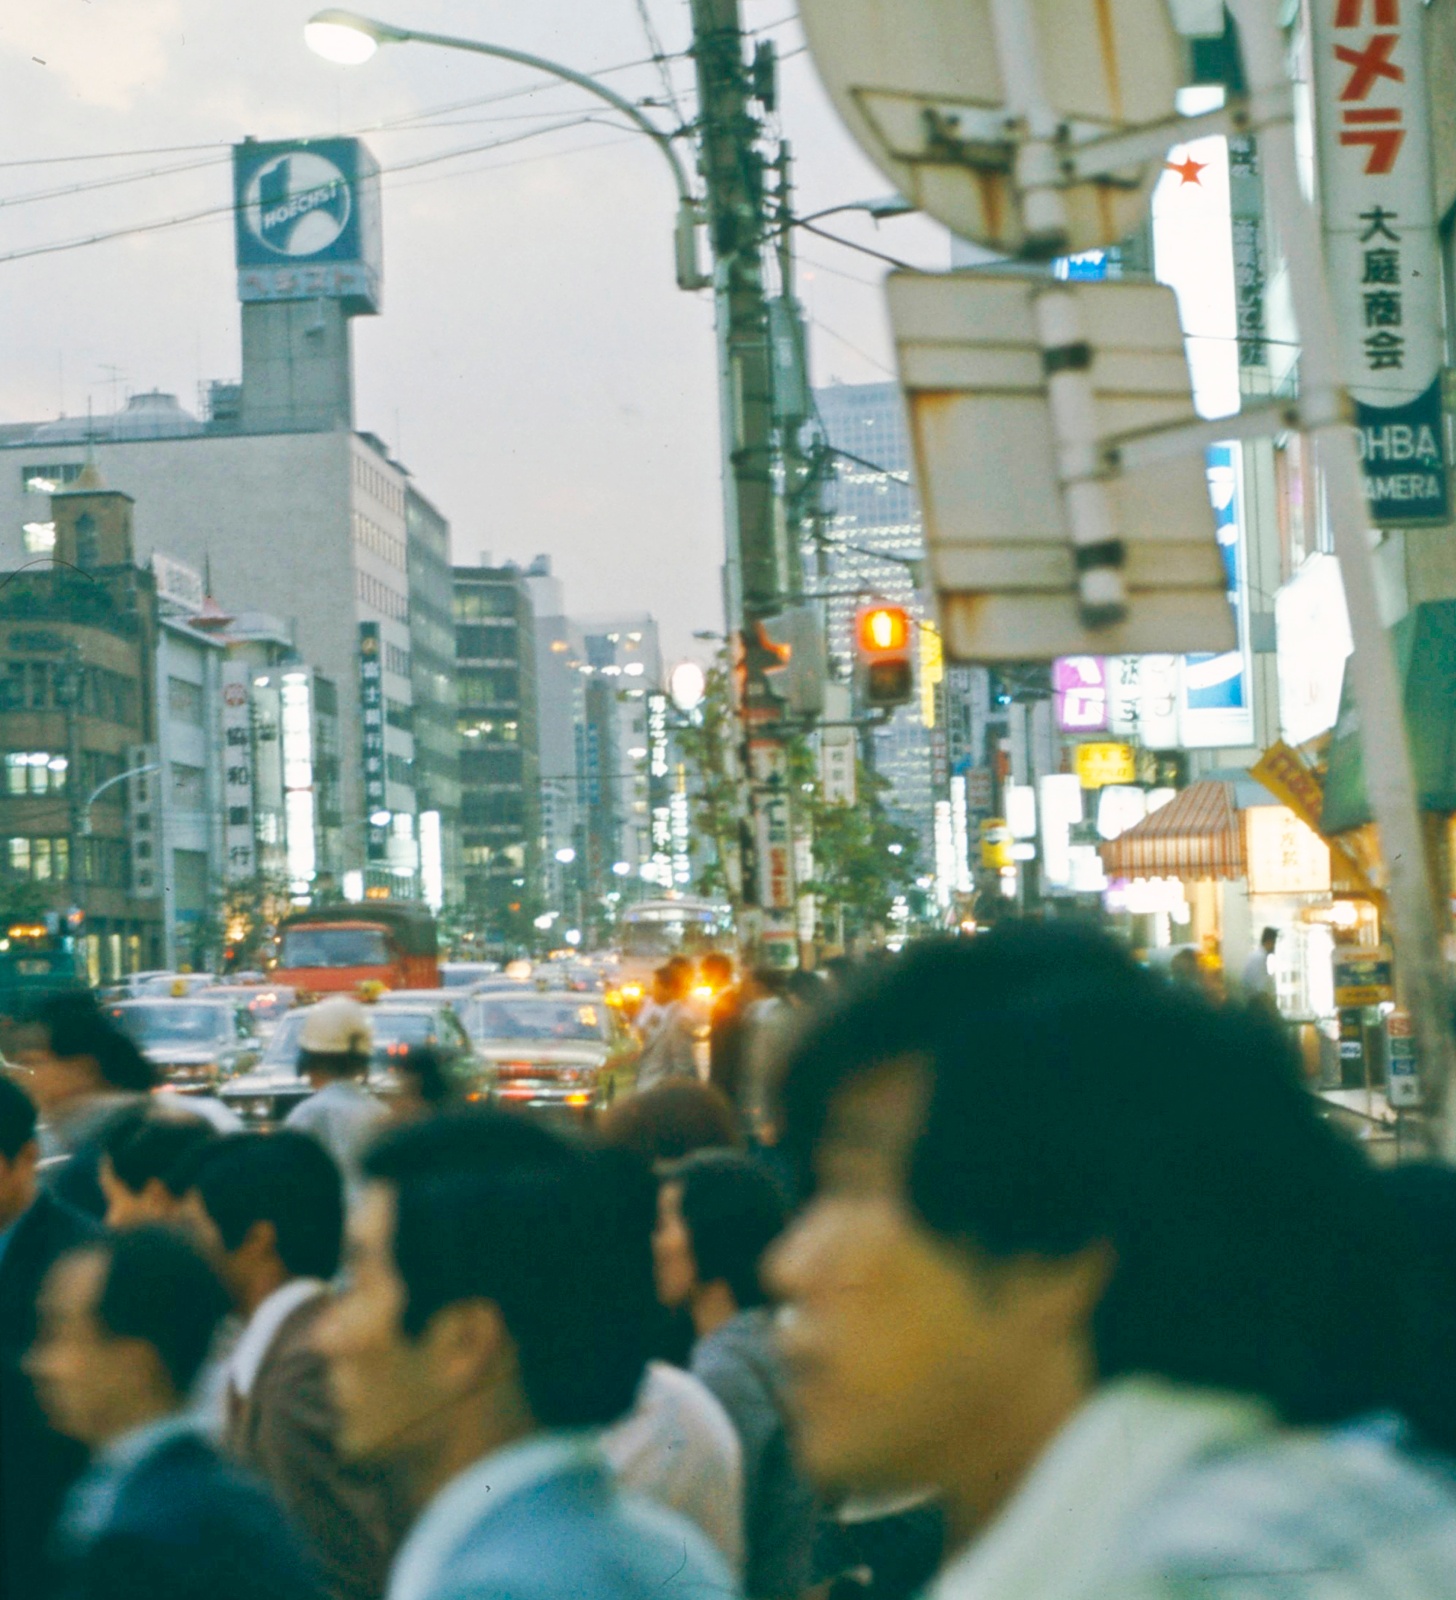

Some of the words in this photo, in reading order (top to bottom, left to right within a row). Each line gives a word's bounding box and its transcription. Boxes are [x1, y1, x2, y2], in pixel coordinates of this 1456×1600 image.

[1359, 205, 1405, 370] 大庭商会
[1362, 473, 1440, 500] AMERA
